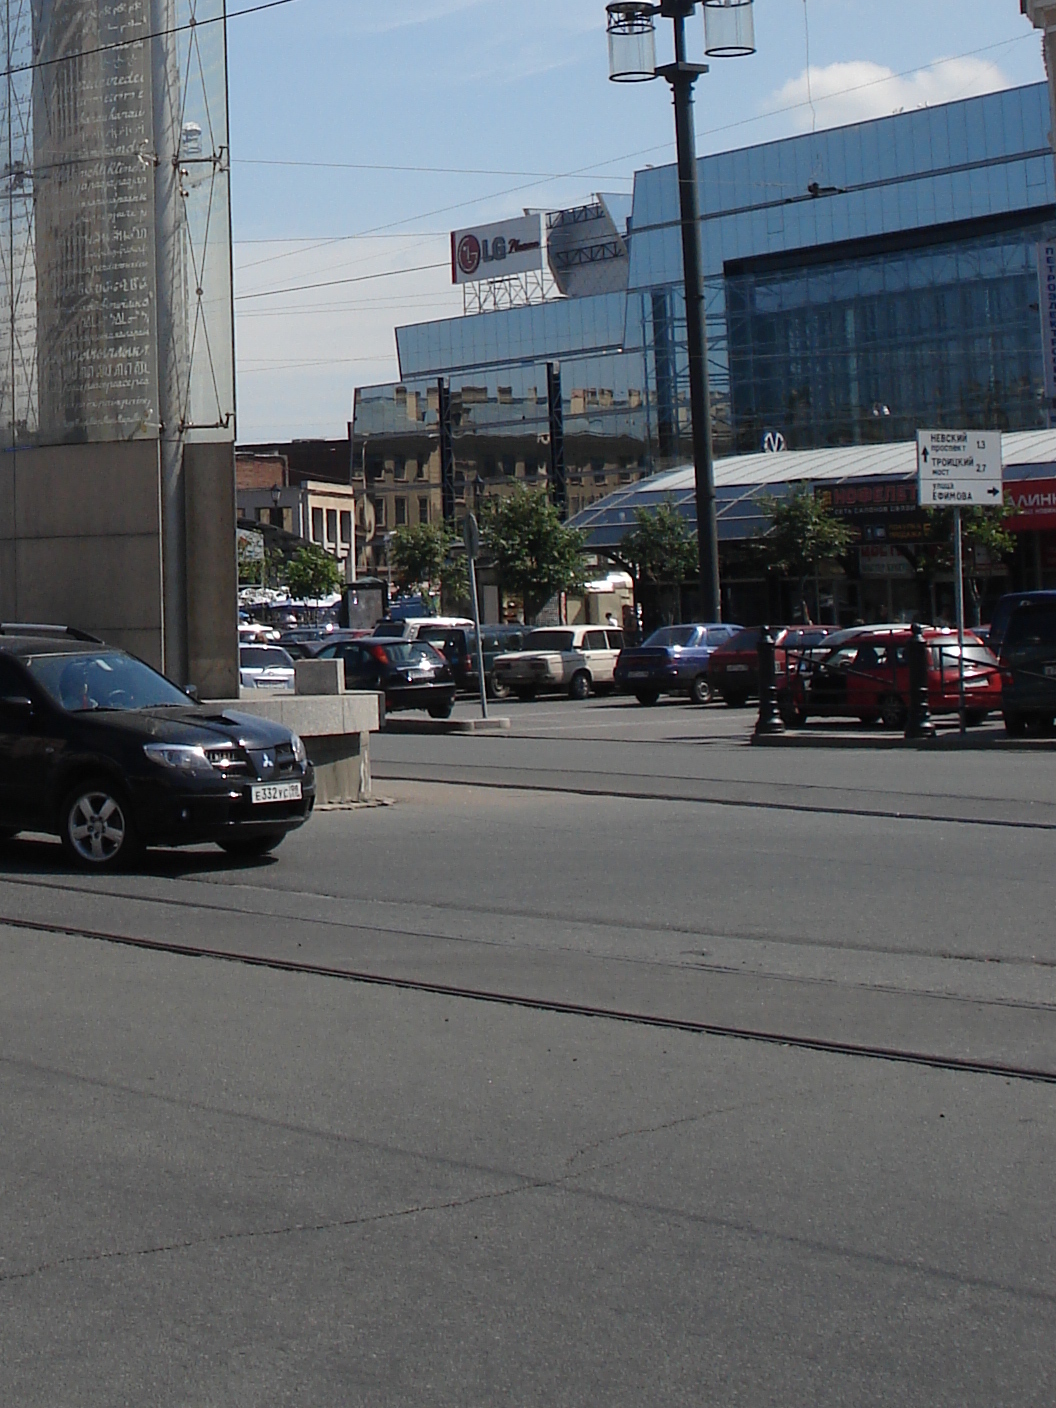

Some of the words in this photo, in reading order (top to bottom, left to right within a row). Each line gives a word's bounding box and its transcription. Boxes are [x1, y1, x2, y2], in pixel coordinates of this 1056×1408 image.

[481, 237, 507, 262] LG
[930, 432, 967, 443] НЕВСКИЙ
[931, 456, 974, 468] ТРОИЦКИЙ
[932, 491, 973, 501] ЕФИМОВА
